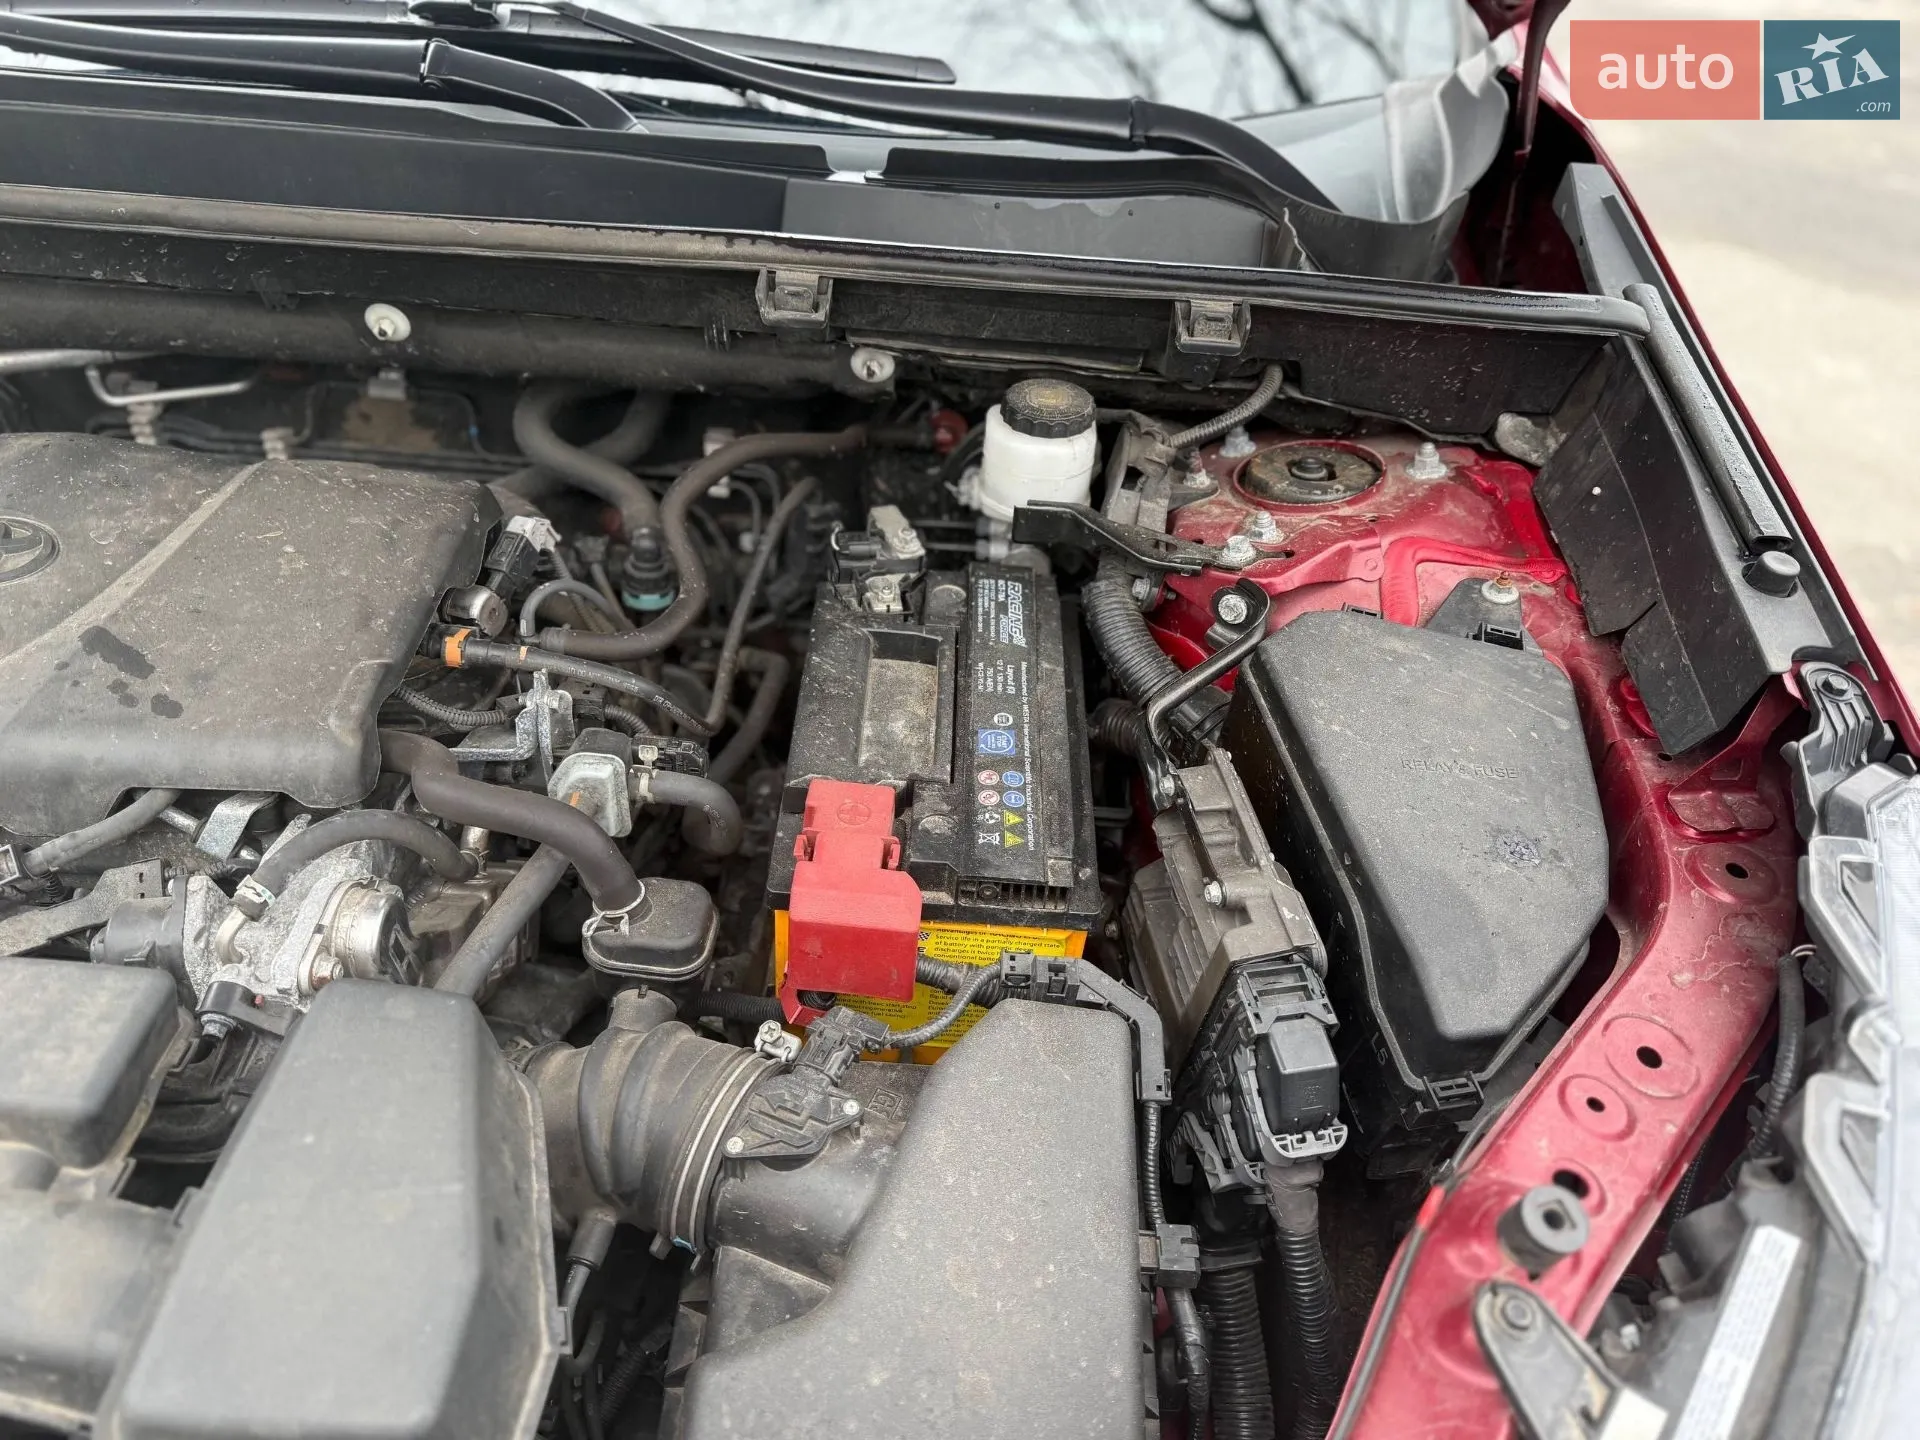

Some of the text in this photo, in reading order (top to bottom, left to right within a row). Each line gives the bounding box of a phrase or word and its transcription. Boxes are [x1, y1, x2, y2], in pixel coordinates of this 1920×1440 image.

[1007, 581, 1023, 637] RACING
[1000, 614, 1008, 644] FORCE
[1006, 665, 1015, 685] Layout
[1021, 696, 1028, 704] by
[1023, 723, 1031, 756] International
[1400, 759, 1454, 774] RELAY
[1473, 764, 1518, 779] FUSE
[1026, 785, 1034, 812] Industrial
[934, 946, 970, 954] discharges
[935, 933, 959, 941] Service
[986, 938, 1013, 946] partially
[1014, 940, 1043, 948] charged
